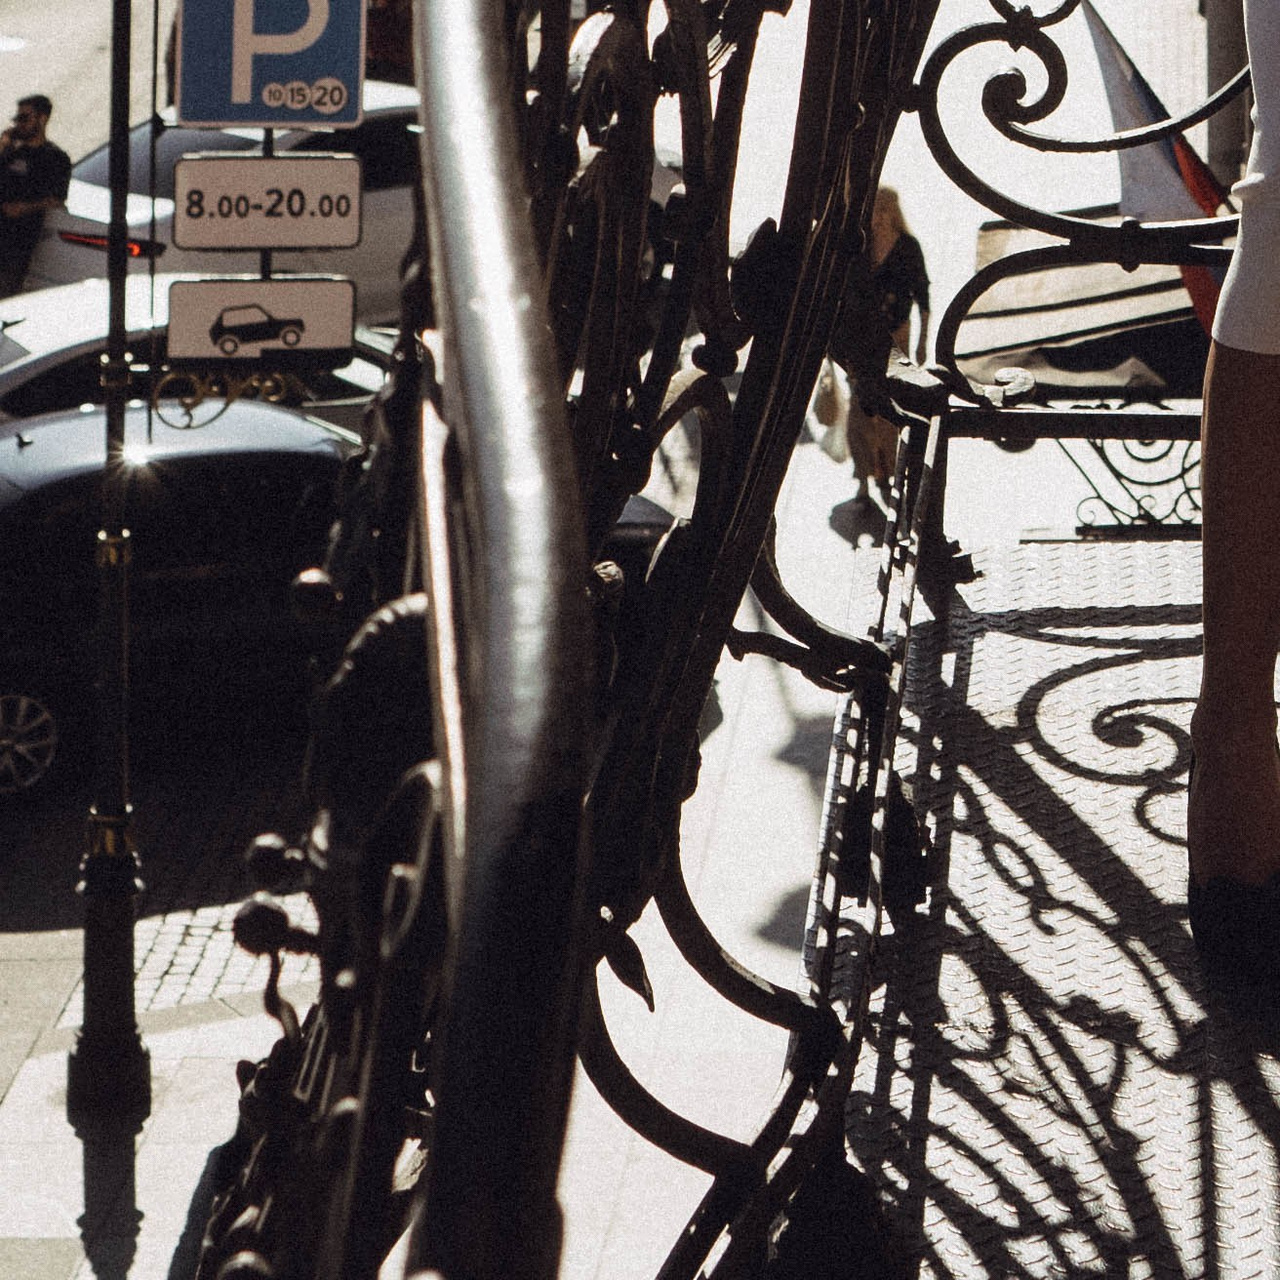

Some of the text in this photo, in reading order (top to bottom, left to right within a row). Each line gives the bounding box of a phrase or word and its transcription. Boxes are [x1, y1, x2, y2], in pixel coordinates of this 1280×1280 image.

[268, 86, 343, 106] 10 15 20
[186, 189, 351, 218] 8.00-20.00
